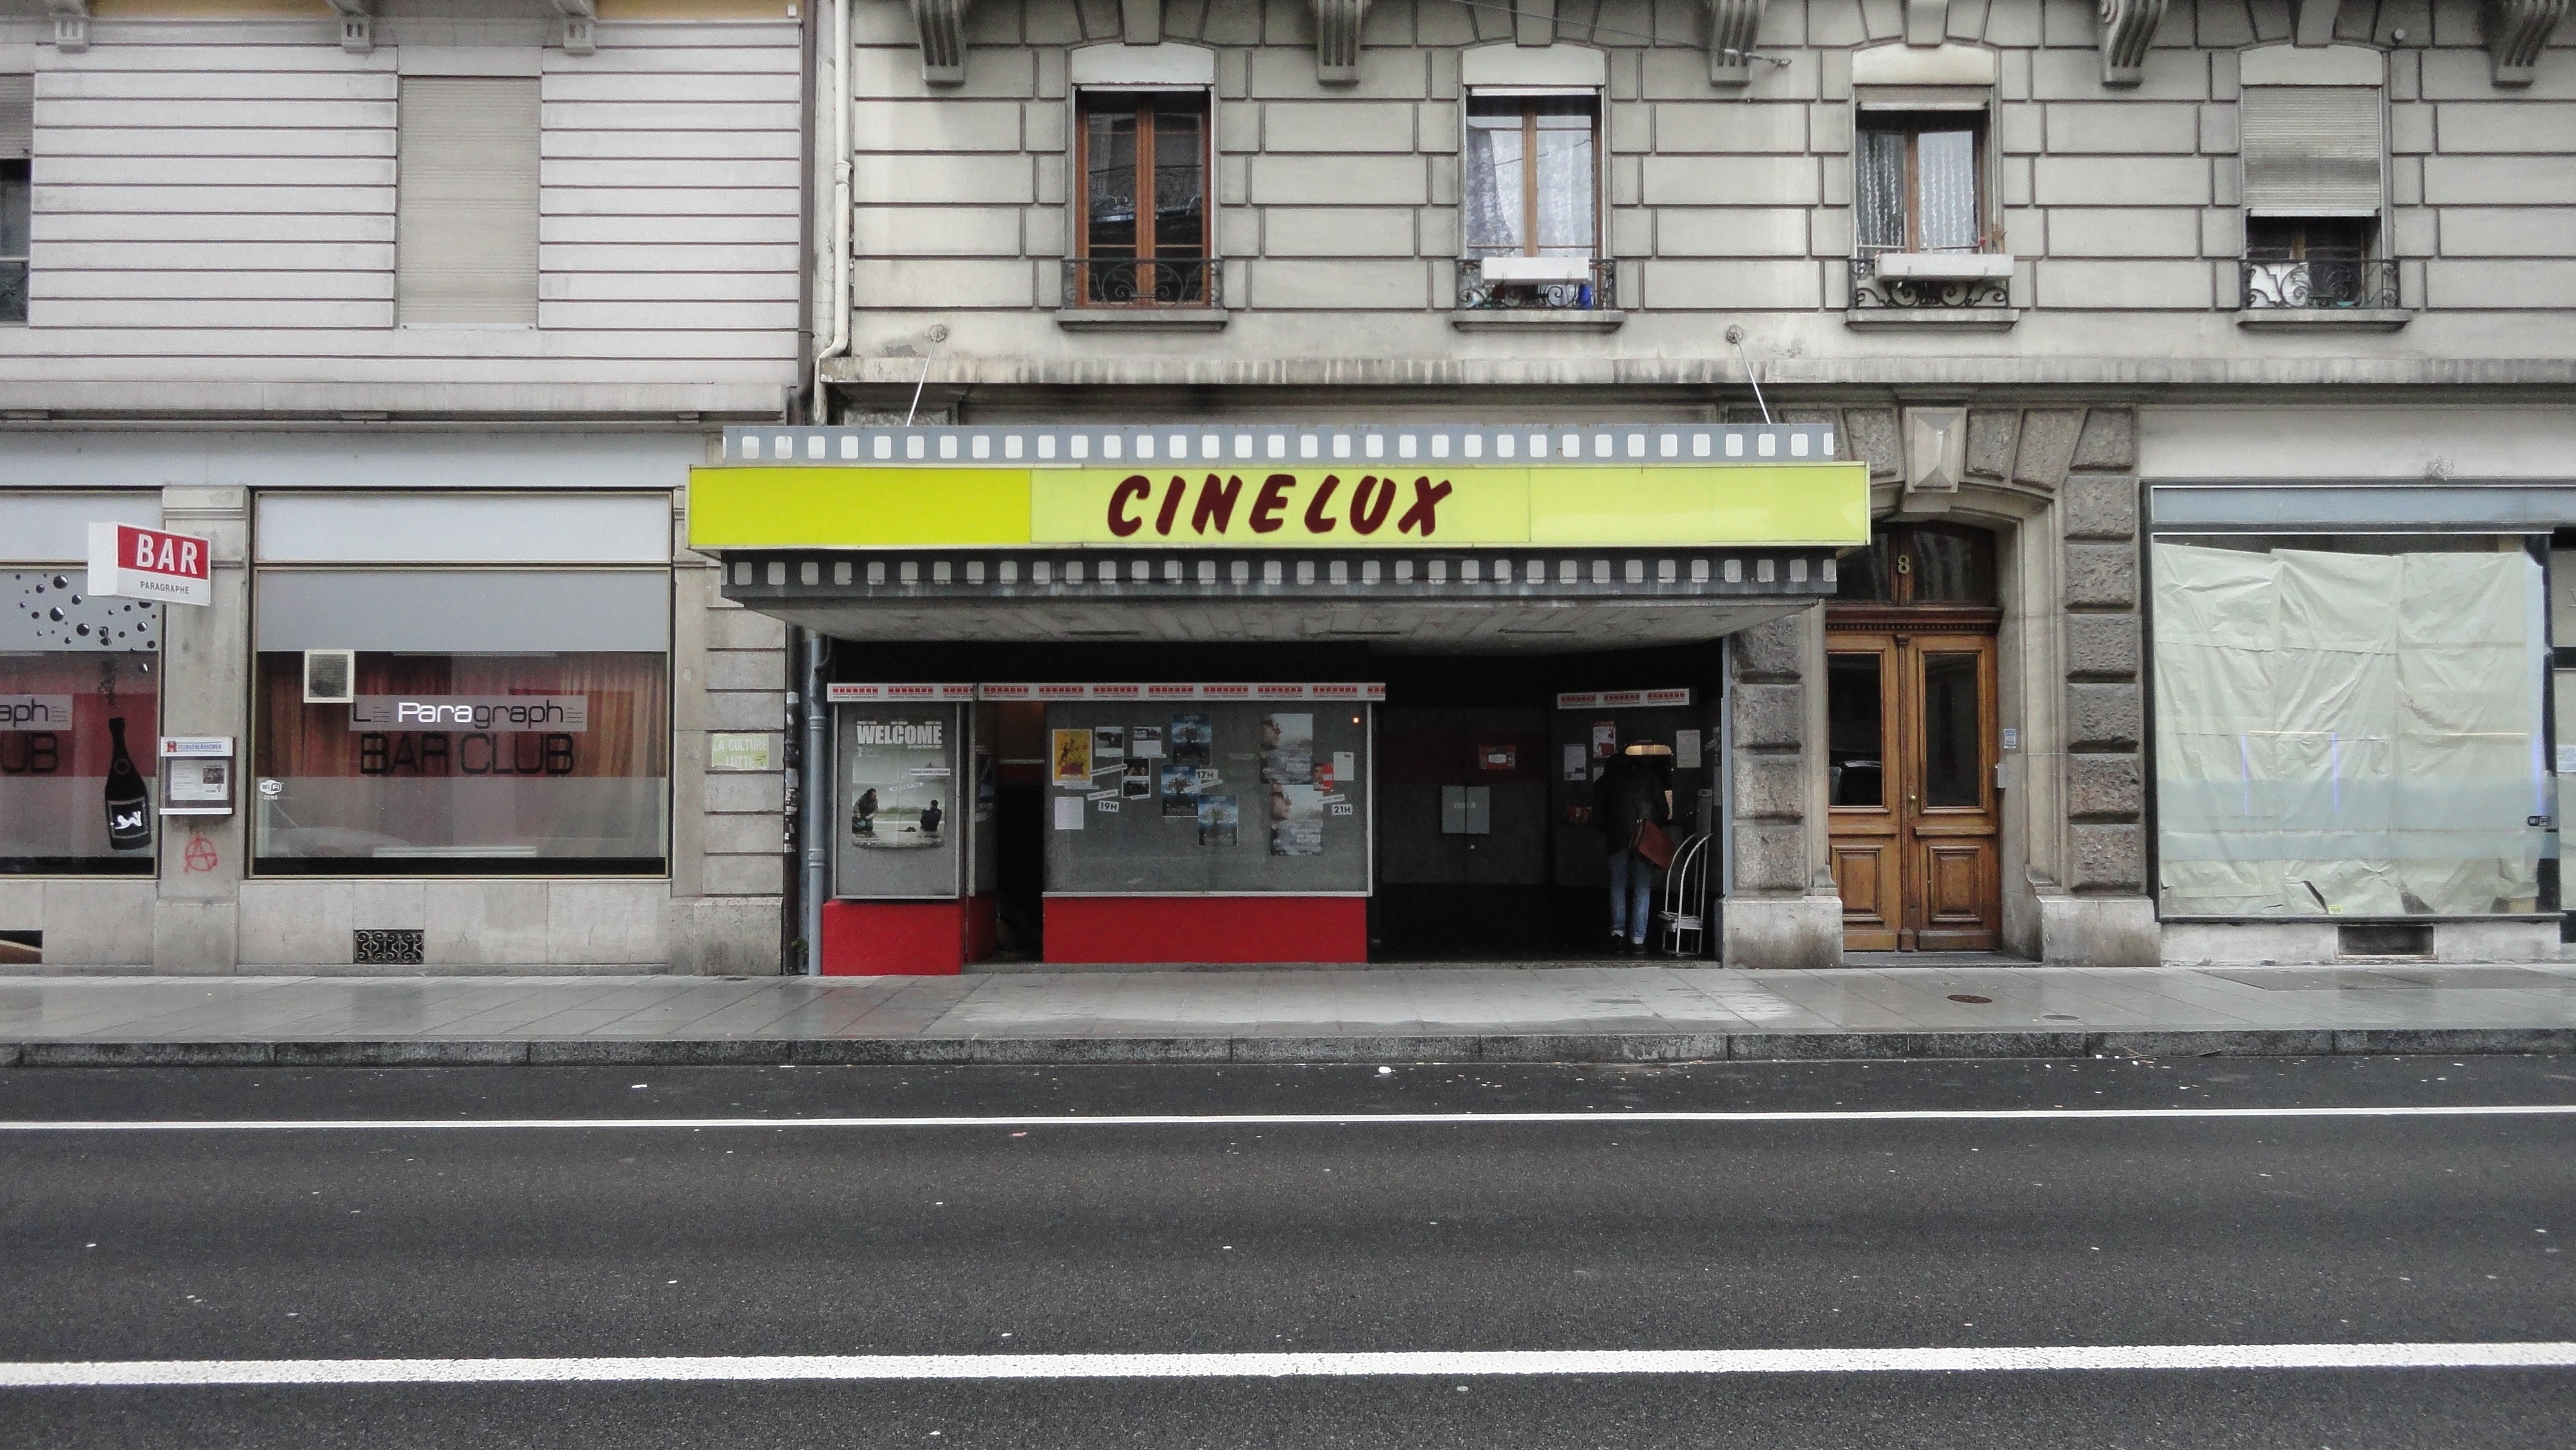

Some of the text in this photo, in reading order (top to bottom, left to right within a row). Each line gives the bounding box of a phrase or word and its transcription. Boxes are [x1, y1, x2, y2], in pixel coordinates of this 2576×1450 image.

[1107, 473, 1453, 537] CINELUX
[136, 533, 198, 575] BAR
[1897, 554, 1911, 574] 8
[140, 581, 190, 594] PARAGRAPHE
[857, 725, 942, 745] WELCOME
[360, 733, 574, 774] BAR CLUB
[1100, 801, 1117, 811] 19H
